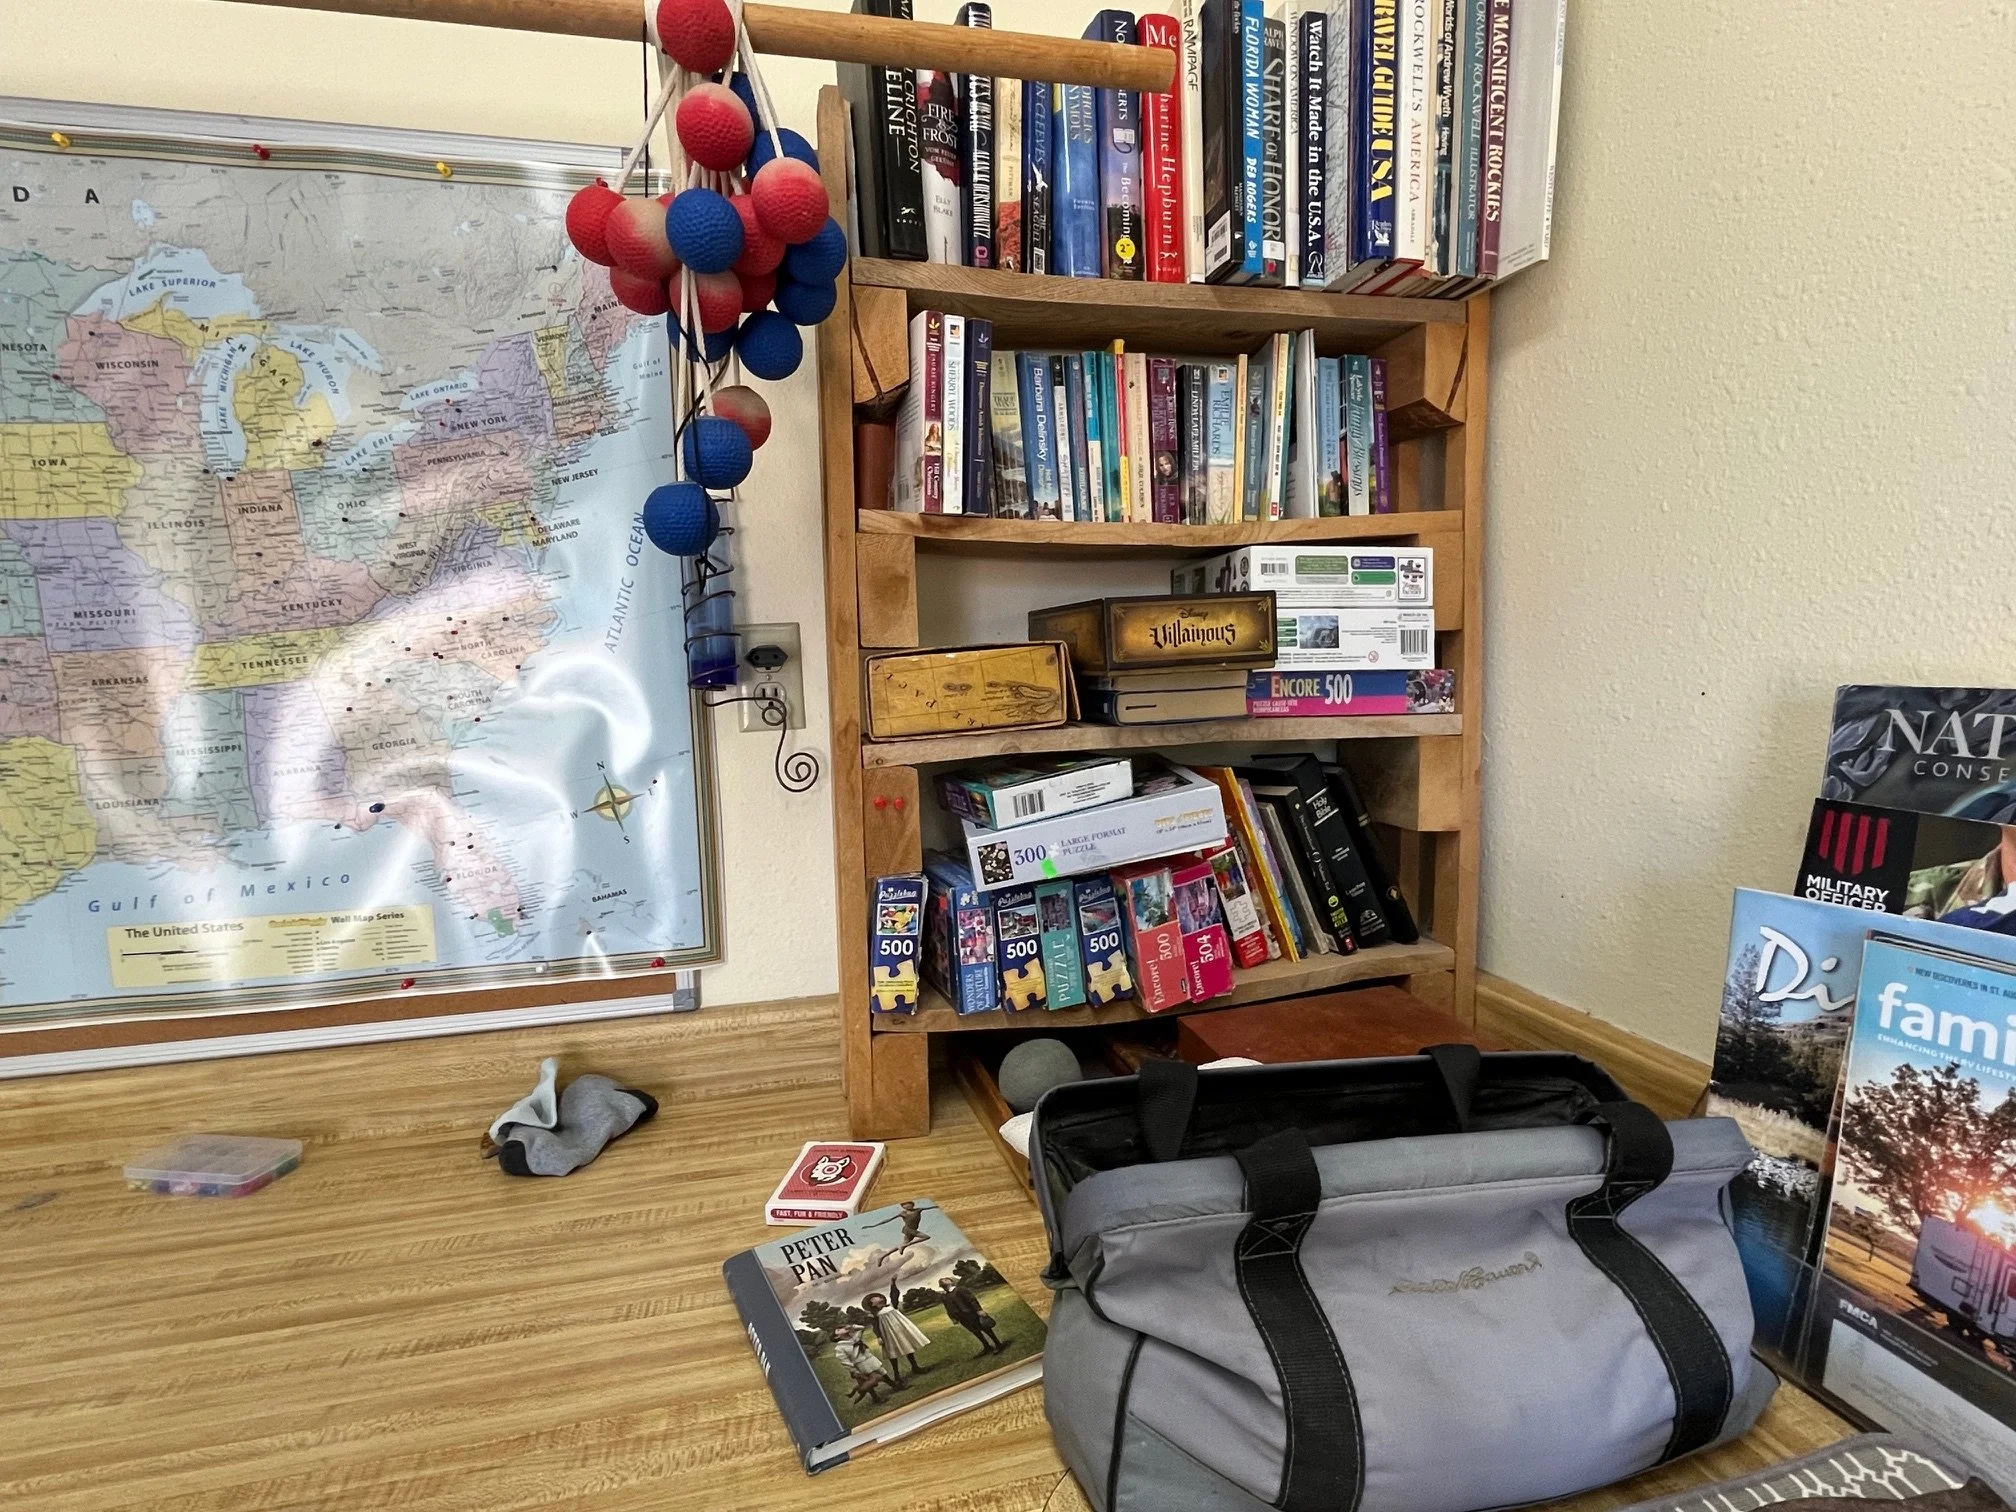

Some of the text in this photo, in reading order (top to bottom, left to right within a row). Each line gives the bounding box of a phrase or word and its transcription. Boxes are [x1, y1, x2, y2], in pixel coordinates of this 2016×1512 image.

[1147, 24, 1178, 48] Me
[1443, 33, 1454, 44] of
[1475, 0, 1487, 60] ORMAN
[1183, 18, 1199, 92] RAMPAGE
[1443, 44, 1454, 84] Andrew
[1245, 16, 1260, 140] FLORIDA WOMAN
[1289, 11, 1299, 135] WINDOW ON AMERICA
[1489, 13, 1509, 141] MAGNIFICENT
[885, 64, 906, 137] ELINE
[928, 103, 955, 121] FIRE
[1069, 85, 1080, 141] NYMOUS
[1263, 58, 1285, 140] SHARE
[1373, 67, 1395, 137] GUIDE
[1441, 85, 1454, 118] Wyeth
[1470, 63, 1483, 142] ROCKWELL
[904, 78, 920, 174] CRICHTON
[1081, 84, 1093, 144] OHOLICS
[923, 127, 957, 150] FROST
[1035, 102, 1047, 165] CLEEVES
[1307, 19, 1323, 248] Watch It Made in the U.S.A.
[1439, 126, 1450, 157] Hoving
[1157, 92, 1178, 245] harine Hepburn
[1371, 138, 1394, 202] USA
[1409, 118, 1422, 203] AMERICA
[1246, 157, 1257, 224] DEB ROGERS
[1467, 147, 1480, 220] ILLUSTRATOR
[1487, 143, 1504, 223] ROCKIES
[973, 182, 992, 240] DERSHOWITZ
[1263, 159, 1284, 243] HONOR
[1031, 196, 1041, 249] SEAGULL
[129, 277, 217, 297] LAKE SUPERIOR
[95, 359, 160, 370] WISCONSIN
[290, 340, 340, 395] LAKE HURON
[219, 346, 237, 429] LAKE MICHIGAN
[410, 382, 469, 401] LAKE ONTARIO
[947, 361, 956, 432] SHERRYL WOODS
[1033, 367, 1047, 462] Barbara Delinsky
[1219, 390, 1230, 427] EMILIE
[457, 415, 508, 432] NEW YORK
[1211, 400, 1222, 455] RICHARDS
[32, 458, 68, 468] IOWA
[344, 434, 395, 466] LAKE ERIE
[427, 450, 487, 466] PENNSYLVANIA
[1350, 403, 1365, 497] Family Blessings
[551, 468, 599, 486] NEW JERSEY
[238, 503, 284, 514] INDIANA
[337, 499, 367, 510] OHIO
[148, 519, 206, 531] ILLINOIS
[532, 531, 579, 547] MARYLAND
[537, 518, 581, 534] DELAWARE
[626, 512, 646, 567] OCEAN
[393, 549, 427, 560] VIRGINIA
[397, 541, 418, 550] WEST
[452, 560, 493, 574] VIRGINIA
[73, 608, 137, 619] MISSOURI
[281, 599, 343, 613] KENTUCKY
[604, 577, 635, 654] ATLANTIC
[1177, 607, 1209, 621] Disney
[461, 640, 492, 651] NORTH
[1149, 620, 1236, 649] Villainous
[242, 655, 310, 670] TENNESSEE
[481, 646, 526, 660] CAROLINA
[91, 675, 149, 686] ARKANSAS
[1271, 673, 1353, 704] ENCORE 500
[448, 696, 492, 710] CAROLINA
[372, 737, 417, 751] GEORGIA
[1877, 709, 2016, 761] NAT
[176, 744, 242, 756] MISSISSIPPI
[273, 764, 322, 777] ALABAMA
[596, 761, 605, 771] N
[1913, 760, 2010, 783] CONSE
[96, 798, 160, 811] LOUISIANA
[1312, 796, 1328, 811] Holy
[1315, 805, 1332, 819] Bible
[1014, 827, 1126, 866] 300 LARGE FORMAT
[1062, 843, 1097, 856] PUZZLE
[457, 866, 498, 881] FLORIDA
[1806, 874, 1890, 902] MILITARY
[88, 874, 350, 913] Gulf of Mexico
[592, 889, 628, 903] BAHAMAS
[1805, 888, 1888, 912] OFFICER
[125, 922, 244, 939] The United States
[331, 915, 351, 925] Wall
[353, 913, 374, 925] Map
[376, 911, 405, 921] Series
[880, 939, 914, 956] 500
[1007, 940, 1038, 959] 500
[1089, 932, 1119, 953] 500
[1157, 933, 1172, 961] 500
[1197, 934, 1215, 963] 504
[966, 973, 975, 1013] WONDERS
[975, 968, 984, 1000] NATURE
[1915, 967, 1932, 978] NEW
[1933, 971, 1979, 990] DISCOVERIES
[1980, 983, 1988, 993] IN
[1990, 985, 2000, 996] ST.
[1878, 982, 2016, 1067] fami
[1878, 1033, 1938, 1058] ENHANCING
[1939, 1051, 1959, 1063] THE
[1960, 1058, 1975, 1070] RV
[814, 1211, 843, 1219] FRIENDLY
[780, 1227, 855, 1265] PETER
[791, 1254, 840, 1285] PAN
[1838, 1298, 1878, 1330] FMCA
